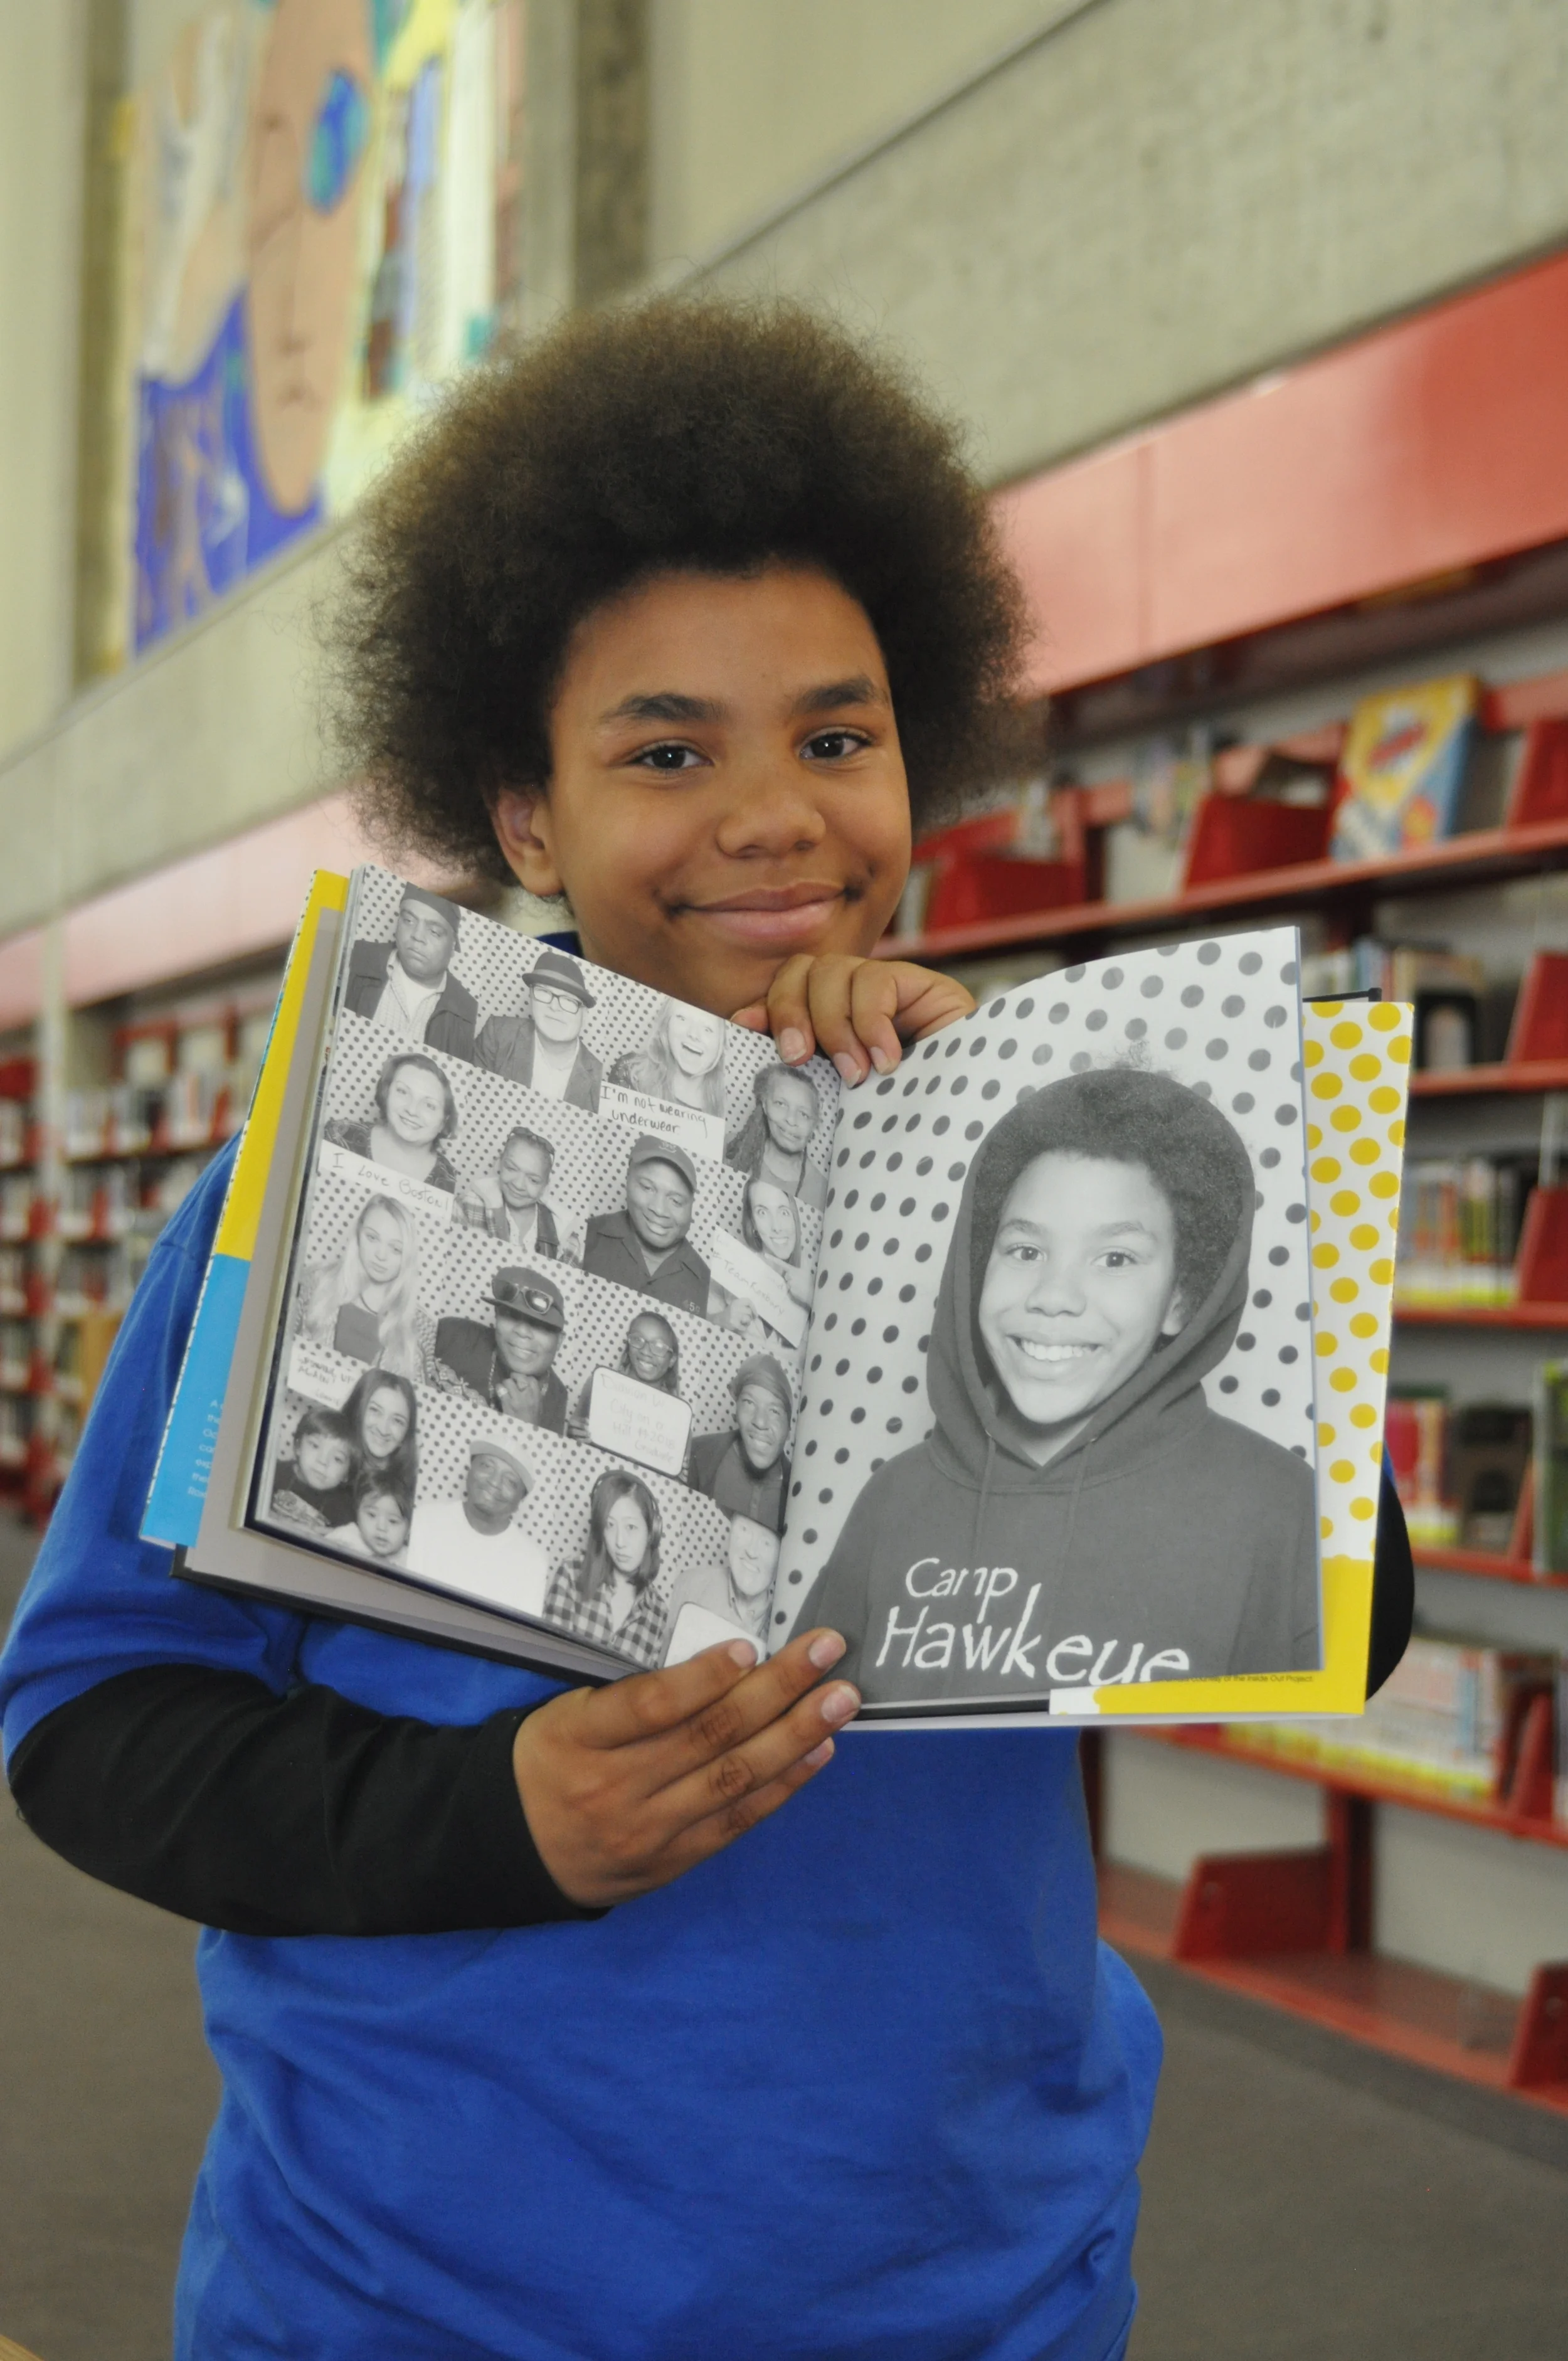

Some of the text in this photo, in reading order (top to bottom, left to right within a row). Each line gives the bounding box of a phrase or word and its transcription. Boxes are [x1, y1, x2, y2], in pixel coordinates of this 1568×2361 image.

[600, 1085, 707, 1138] I'm not wearing
[332, 1152, 344, 1169] I
[906, 1557, 1019, 1623] Camp
